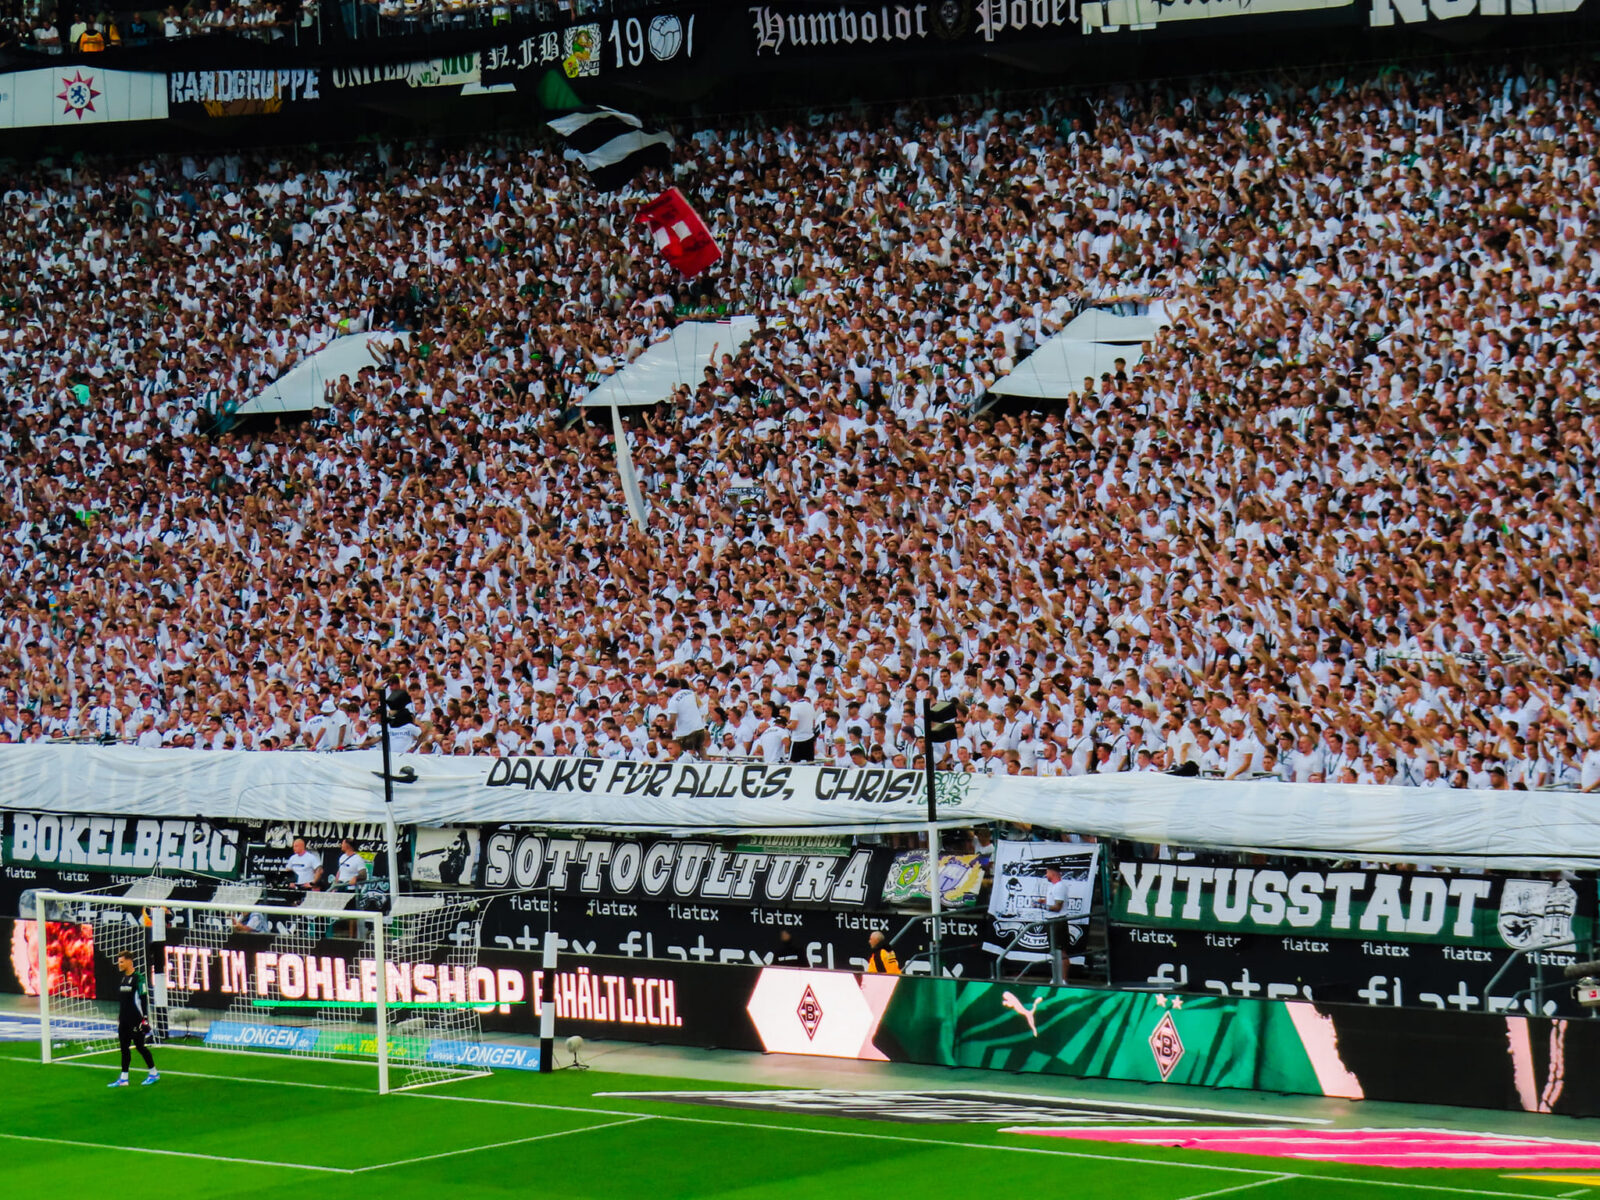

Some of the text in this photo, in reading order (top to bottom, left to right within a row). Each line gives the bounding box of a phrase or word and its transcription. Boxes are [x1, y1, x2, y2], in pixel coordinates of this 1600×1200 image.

[749, 4, 928, 56] Humboldt
[171, 68, 320, 103] RANDGRUPPE
[486, 757, 924, 804] DANKE FÜR ALLES, CHRIS!
[294, 821, 404, 844] FRONTLIN
[12, 812, 239, 873] BOKELBERG
[5, 866, 37, 879] flatex
[485, 832, 873, 905] SOTTOCULTURA
[588, 901, 638, 917] flatex
[668, 903, 720, 922] flatex
[750, 907, 803, 927] flatex
[836, 912, 890, 932] flatex
[922, 917, 978, 936] fatex
[1129, 928, 1175, 945] flatex
[1204, 933, 1242, 948] flat
[1282, 937, 1330, 953] flatex
[1361, 941, 1410, 958] flatex
[1442, 945, 1493, 962] flatex
[151, 945, 212, 991] ETZT
[219, 949, 248, 994] IM
[255, 951, 525, 1014] FOHLENSHOP
